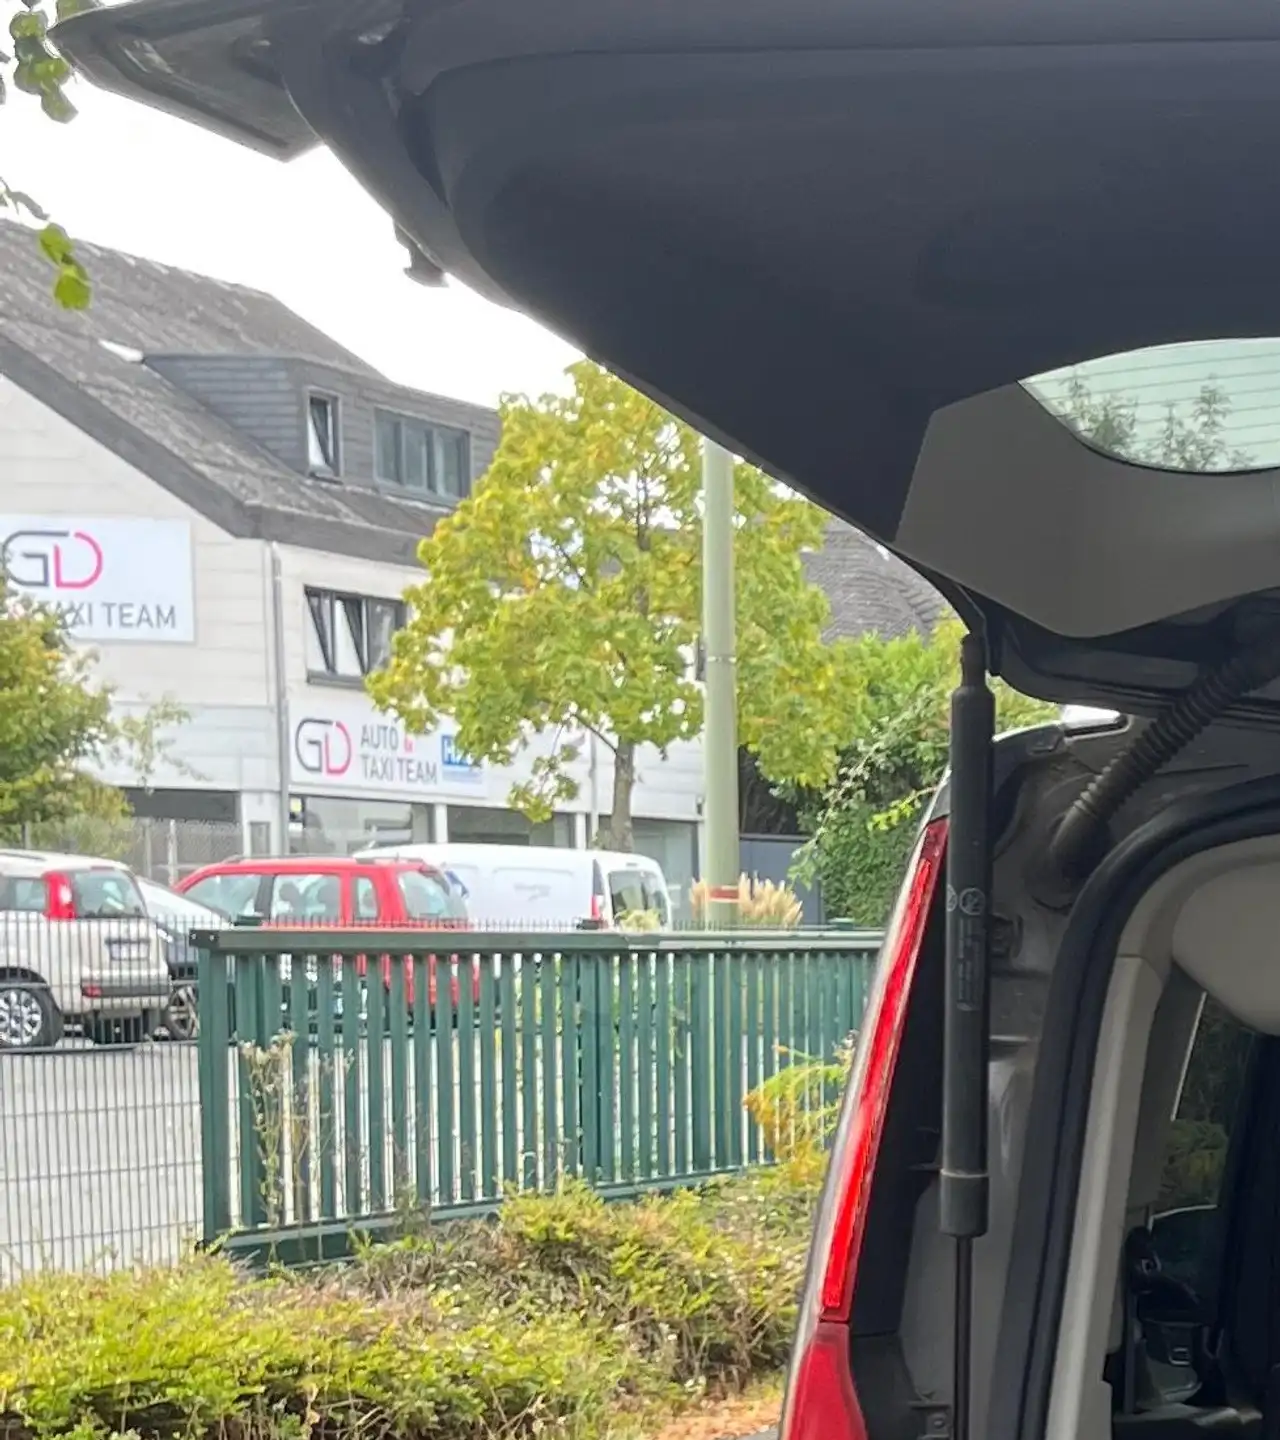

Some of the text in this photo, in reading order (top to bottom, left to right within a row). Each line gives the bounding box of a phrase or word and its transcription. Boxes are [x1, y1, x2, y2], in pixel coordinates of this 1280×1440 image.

[101, 601, 177, 630] TEAM
[295, 717, 353, 775] GD
[360, 724, 399, 752] AUTO
[360, 754, 395, 781] TAXI
[398, 758, 437, 785] TEAM
